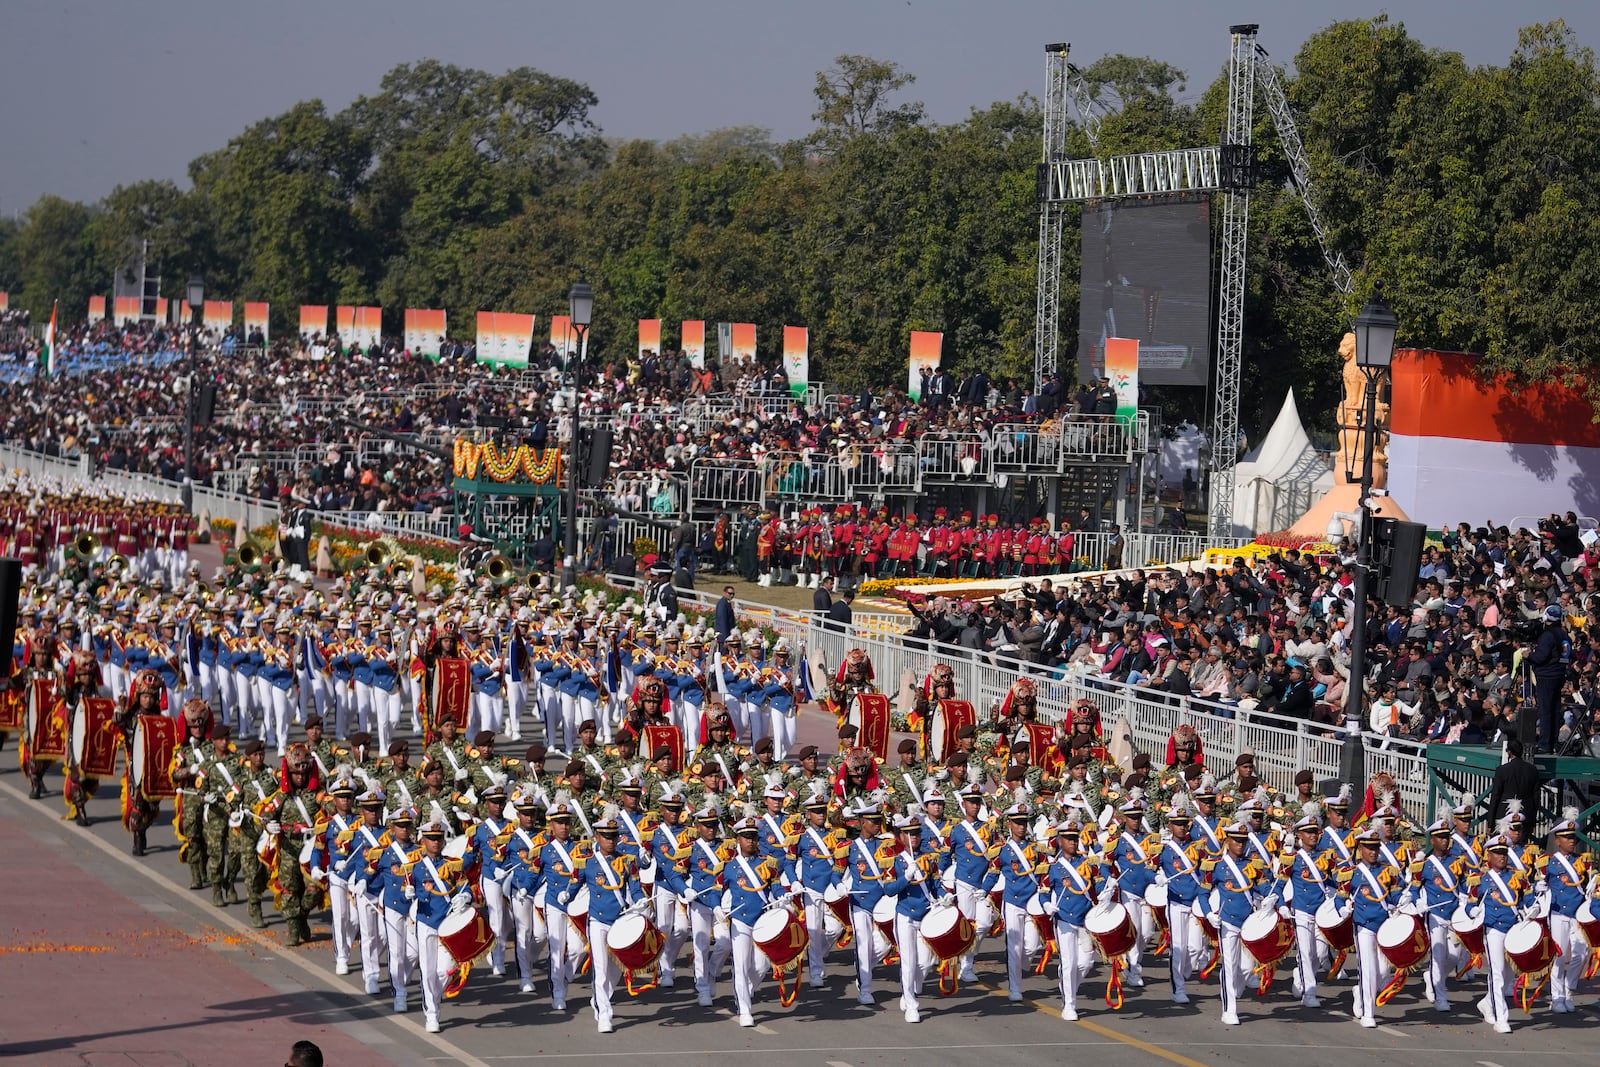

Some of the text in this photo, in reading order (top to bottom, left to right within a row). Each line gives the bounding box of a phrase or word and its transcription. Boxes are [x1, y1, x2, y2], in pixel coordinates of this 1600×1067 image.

[475, 917, 486, 943] I
[789, 922, 805, 948] D
[959, 917, 971, 941] O
[1277, 922, 1291, 947] E
[1413, 930, 1426, 953] S
[642, 930, 658, 955] N
[1541, 936, 1550, 960] I
